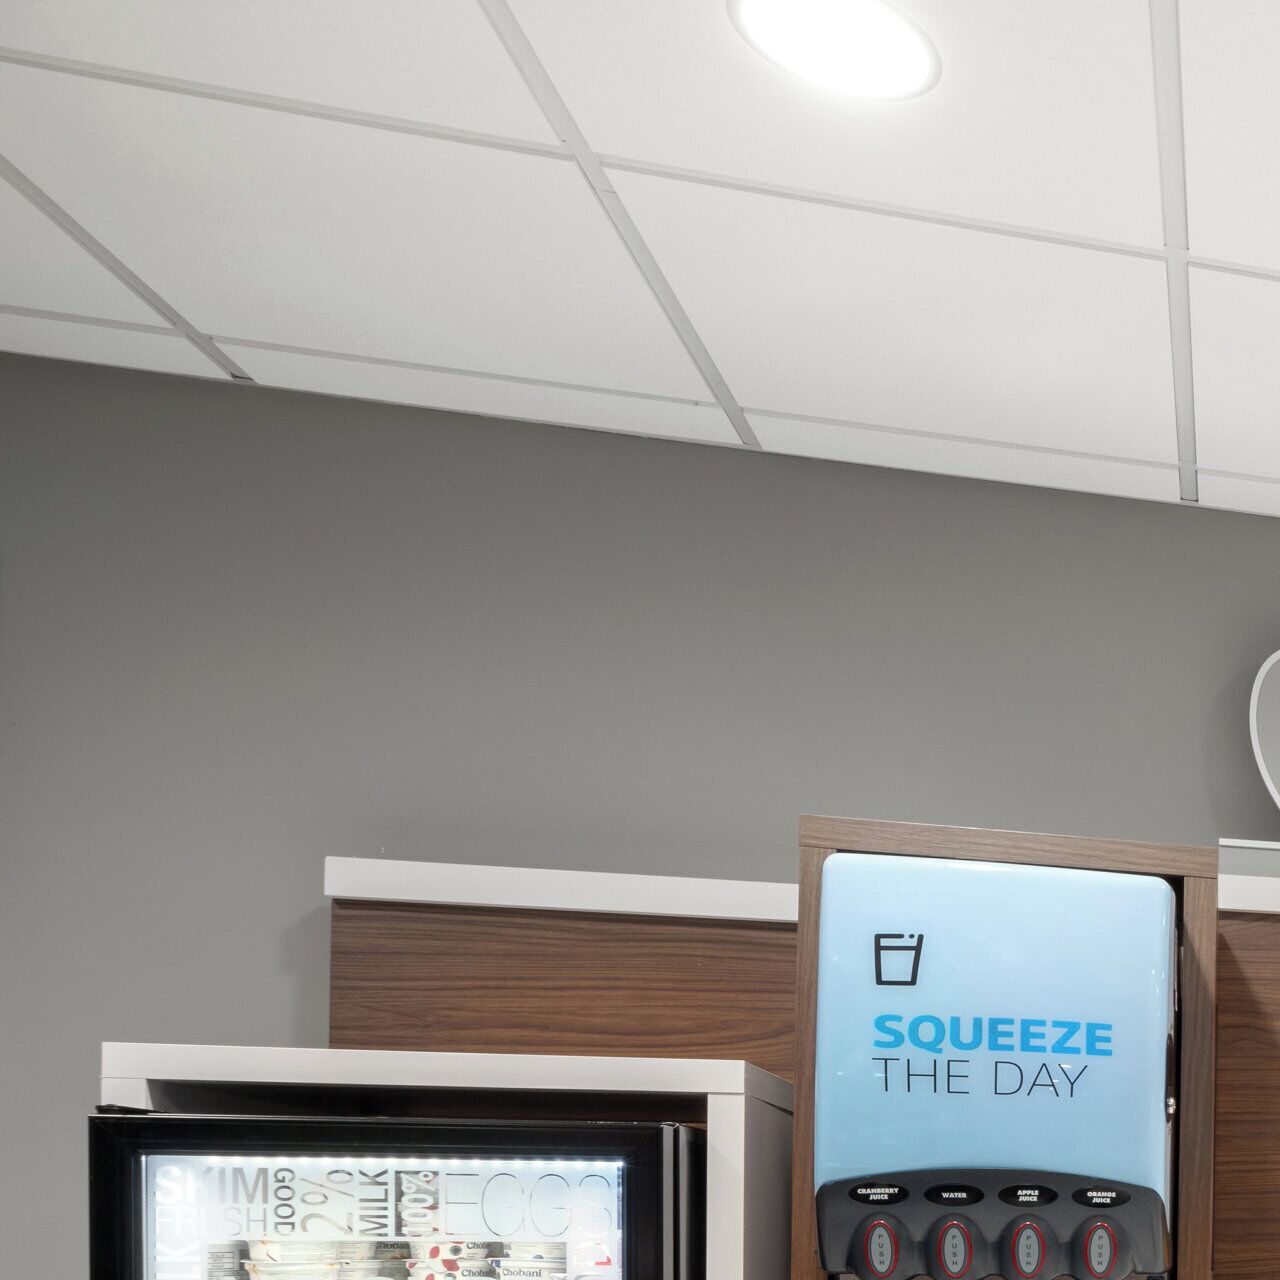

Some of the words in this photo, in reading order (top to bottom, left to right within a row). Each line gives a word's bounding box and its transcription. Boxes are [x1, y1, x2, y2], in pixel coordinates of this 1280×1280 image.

[872, 1014, 1113, 1056] SQUEEZE
[872, 1057, 970, 1094] THE
[994, 1060, 1088, 1098] DAY
[156, 1165, 269, 1204] SKIM
[274, 1167, 296, 1236] GOOD
[359, 1168, 389, 1237] MILK
[445, 1172, 612, 1238] EGGS
[857, 1187, 899, 1195] CRANBERRY
[503, 1268, 542, 1278] Chobani
